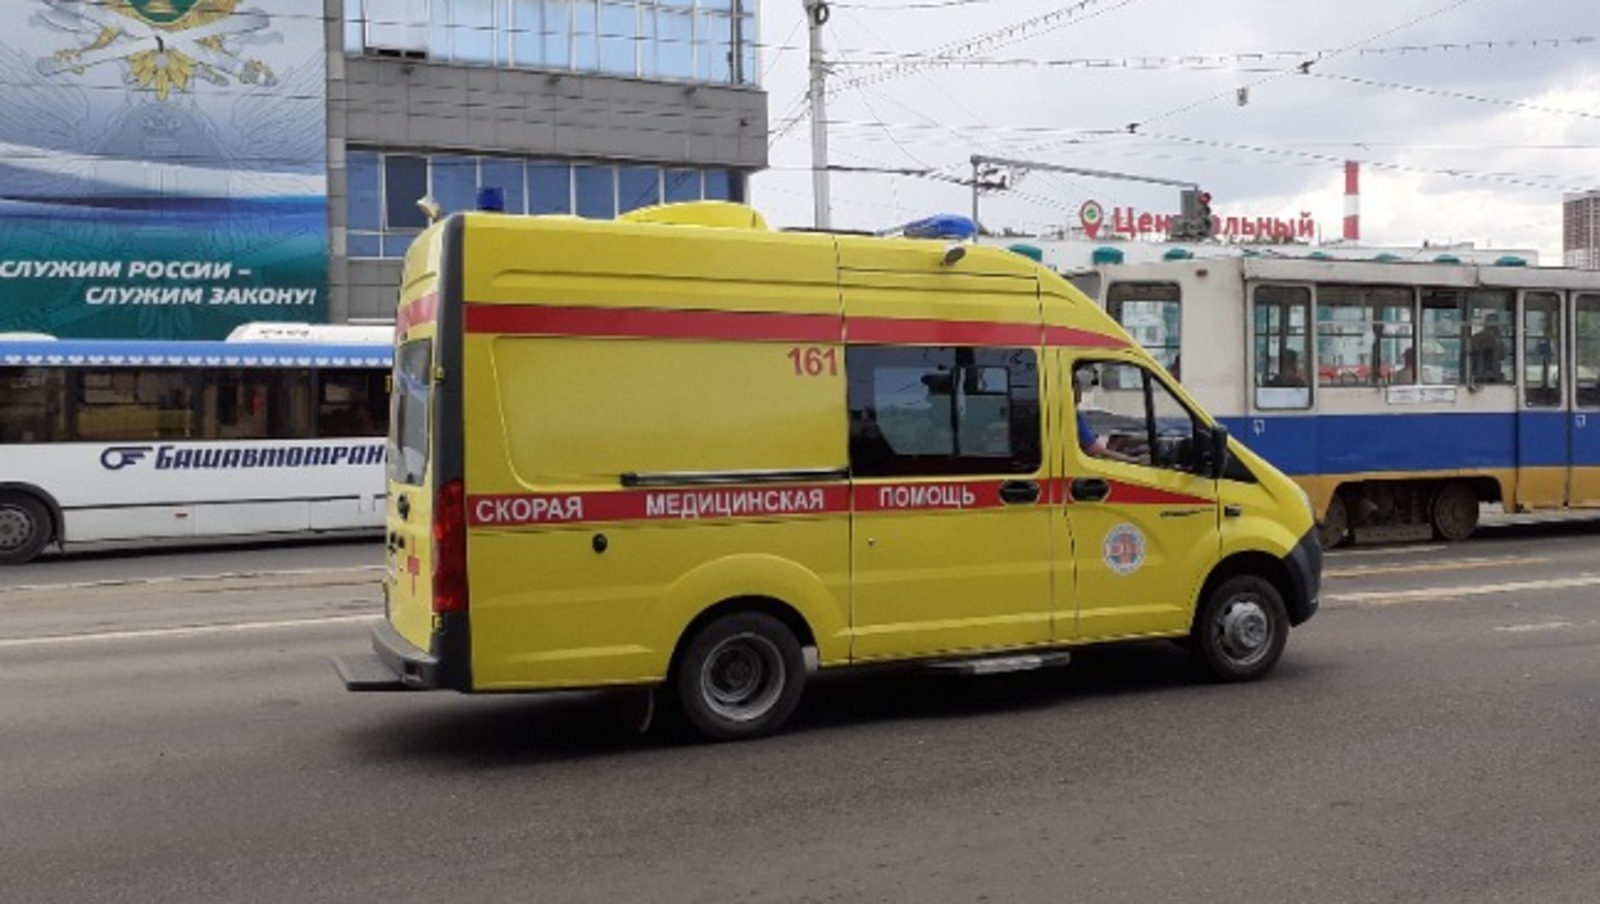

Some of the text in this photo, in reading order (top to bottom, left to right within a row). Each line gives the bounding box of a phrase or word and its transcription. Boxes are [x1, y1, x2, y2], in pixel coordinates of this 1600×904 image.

[1113, 206, 1314, 238] Ценльный
[0, 261, 121, 278] СЛУЖИМ
[128, 261, 232, 279] РОССИИ
[86, 287, 317, 305] СЛУЖИМ ЗАКОНУ!
[787, 347, 838, 376] 161
[475, 484, 976, 523] СКОРАЯ МЕДИЦИНСКАЯ ПОМОЩЬ
